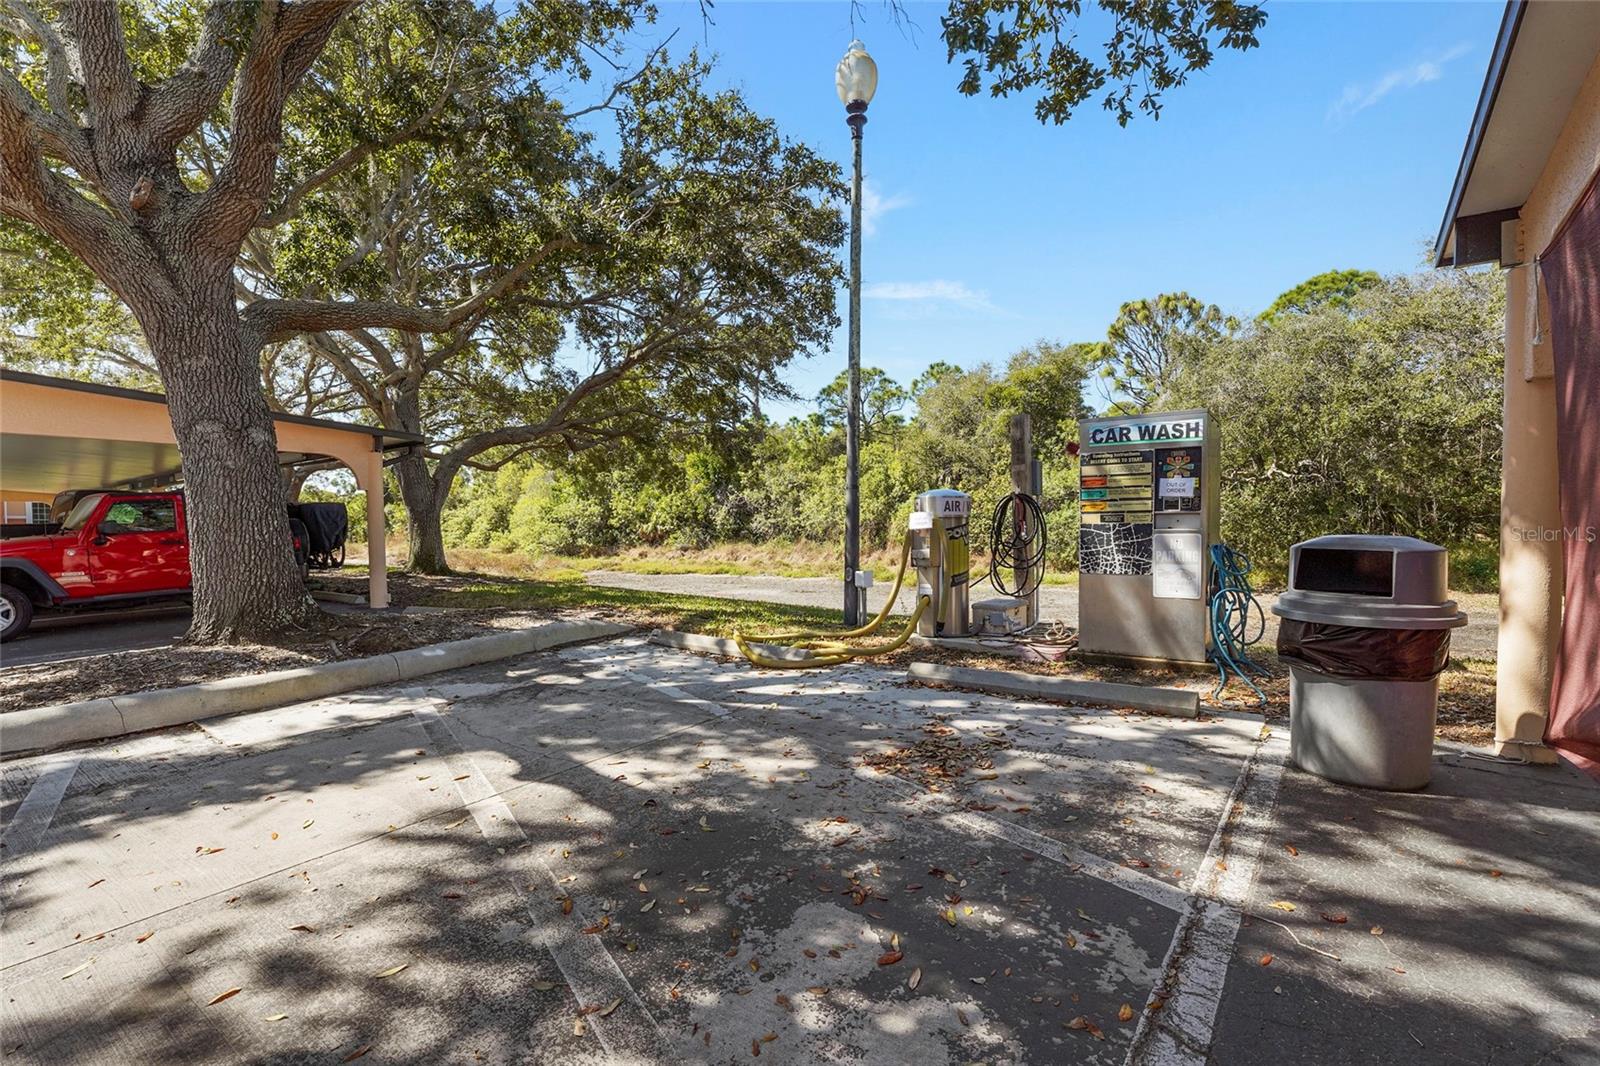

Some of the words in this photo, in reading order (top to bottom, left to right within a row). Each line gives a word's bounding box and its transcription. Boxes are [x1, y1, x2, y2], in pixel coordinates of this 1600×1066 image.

[1092, 426, 1132, 443] CAR
[1138, 422, 1200, 441] WASH
[943, 500, 961, 512] AIR
